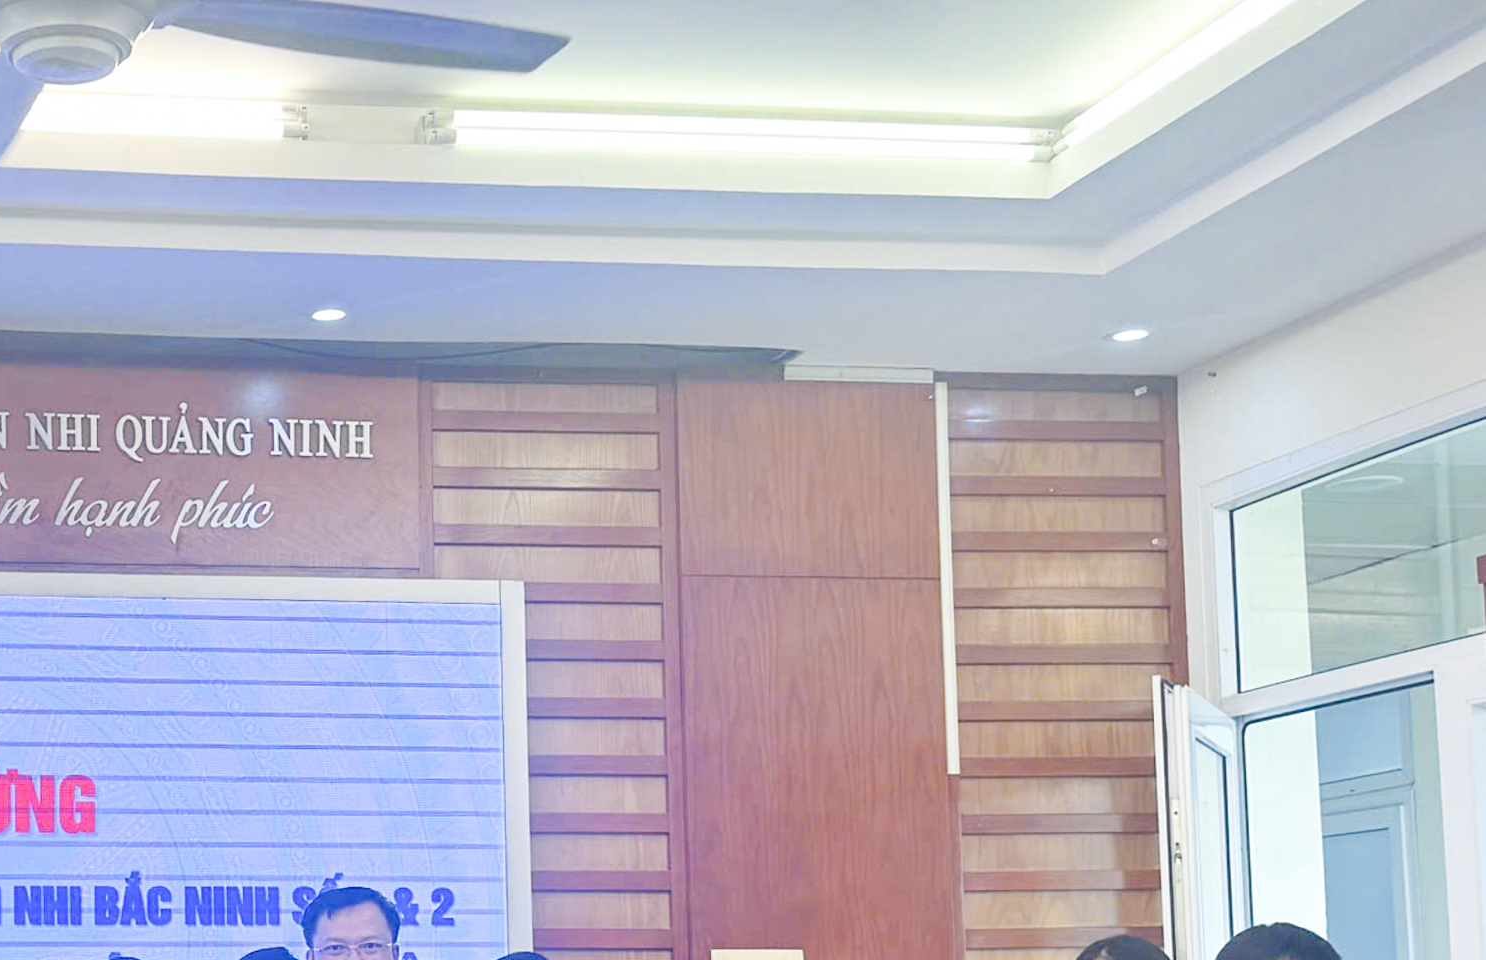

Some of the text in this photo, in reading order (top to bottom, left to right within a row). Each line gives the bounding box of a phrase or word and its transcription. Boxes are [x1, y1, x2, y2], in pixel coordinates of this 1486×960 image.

[25, 412, 101, 452] NHI
[115, 402, 254, 463] QUẢNG
[268, 418, 374, 459] NINH
[55, 477, 160, 538] hạnh
[170, 479, 274, 544] phúc
[14, 885, 82, 926] NHI
[94, 871, 172, 926] BẮC
[185, 886, 280, 926] NINH
[431, 887, 455, 926] 2
